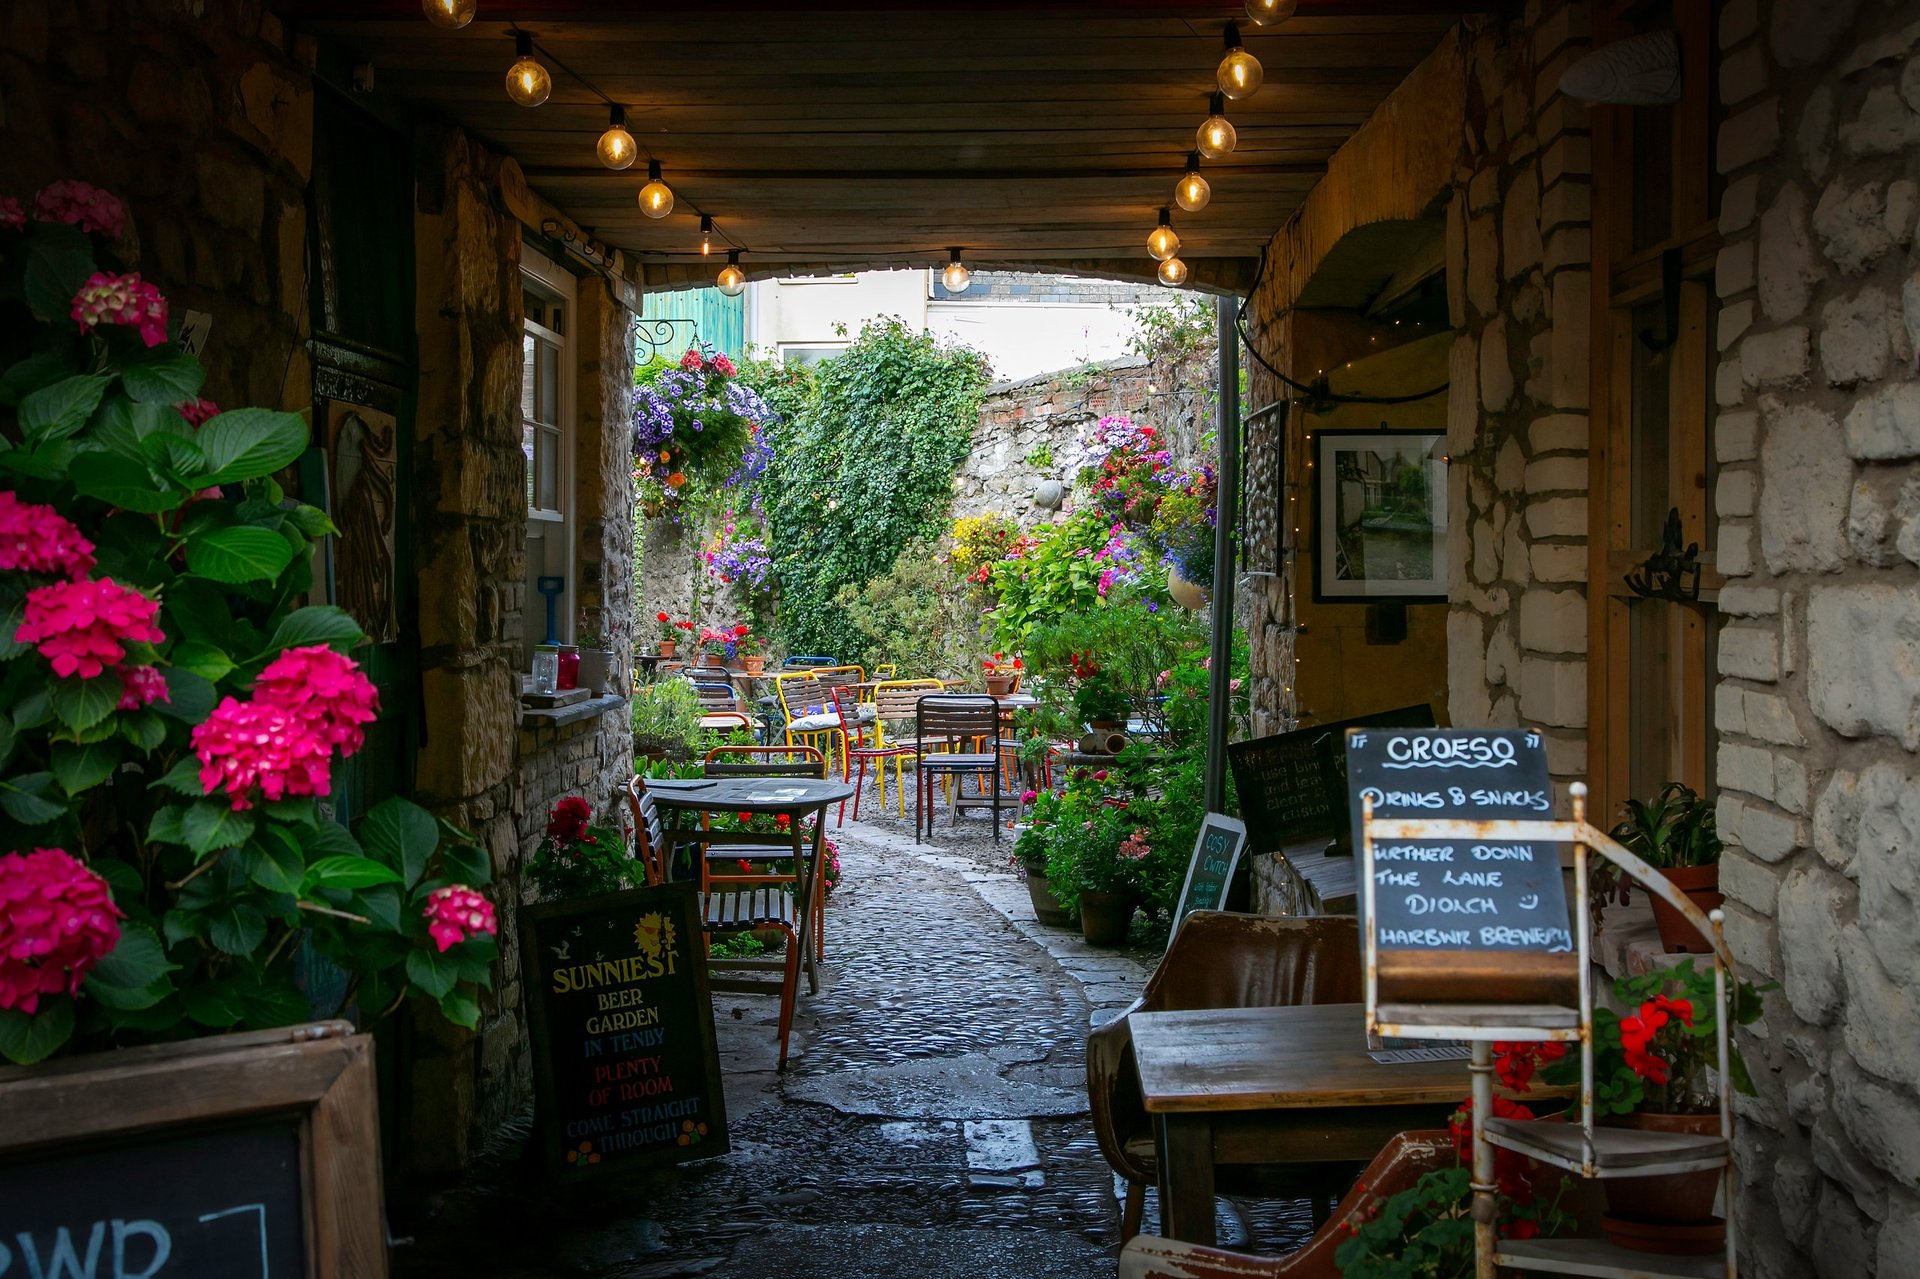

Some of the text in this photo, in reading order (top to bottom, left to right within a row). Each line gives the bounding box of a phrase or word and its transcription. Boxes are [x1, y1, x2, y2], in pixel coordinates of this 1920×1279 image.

[1386, 734, 1515, 762] CROESO
[1358, 786, 1445, 809] DRINKS
[1469, 789, 1550, 811] SNACKS
[1206, 833, 1230, 856] COSY
[1373, 843, 1455, 862] URTHER
[1375, 868, 1504, 888] THE LANE
[1479, 925, 1573, 953] BREWERY
[552, 950, 679, 994] SUNNIEST
[596, 987, 644, 1012] BEER
[585, 1006, 660, 1035] GARDEN
[583, 1026, 666, 1058] IN TENBY
[593, 1055, 662, 1084] PLENTY
[588, 1075, 673, 1107] OF ROOM
[566, 1096, 702, 1138] COME STRAIGHT
[598, 1122, 680, 1153] THROUGH
